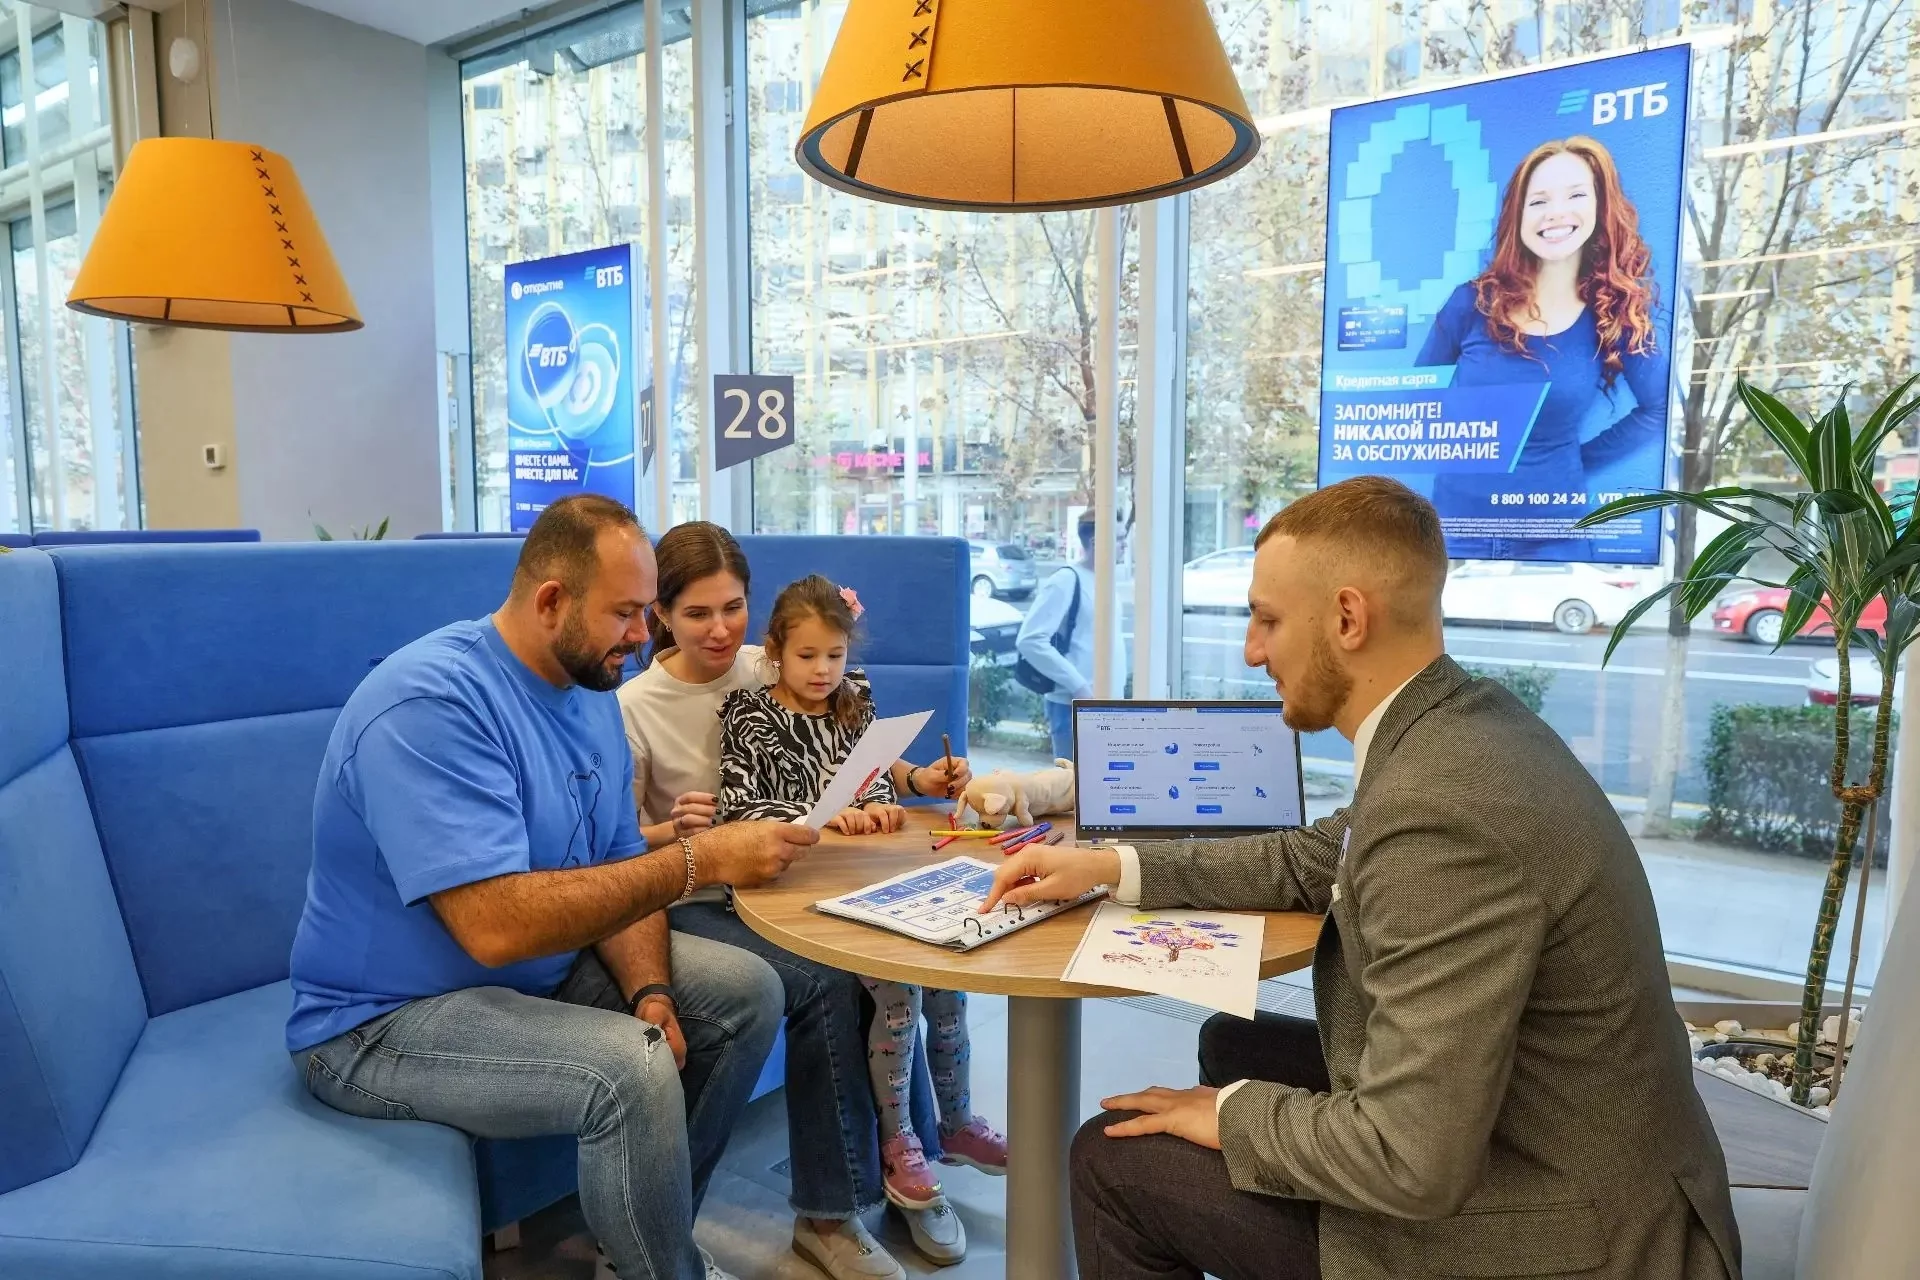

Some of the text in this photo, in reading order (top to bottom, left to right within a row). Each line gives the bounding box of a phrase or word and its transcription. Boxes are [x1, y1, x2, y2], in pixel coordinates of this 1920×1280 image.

[1593, 82, 1669, 126] ВТБ
[596, 265, 624, 288] ВТБ
[523, 280, 564, 295] открытие
[540, 346, 568, 367] ВТБ
[1335, 373, 1437, 391] Кредитная карта
[724, 388, 787, 440] 28
[1334, 402, 1442, 420] ЗАПОМНИТЕ!
[641, 400, 651, 448] 27
[1334, 420, 1498, 441] НИКАКОЙ ПЛАТЫ
[515, 455, 541, 467] ВМЕСТЕ
[1333, 442, 1500, 461] ЗА ОБСЛУЖИВАНИЕ
[515, 468, 578, 482] ВМЕСТЕ ДЛЯ ВАС
[1491, 493, 1498, 505] 8
[1501, 493, 1524, 505] 800
[1528, 493, 1549, 505] 100
[1552, 493, 1568, 505] 24
[1571, 493, 1586, 505] 24
